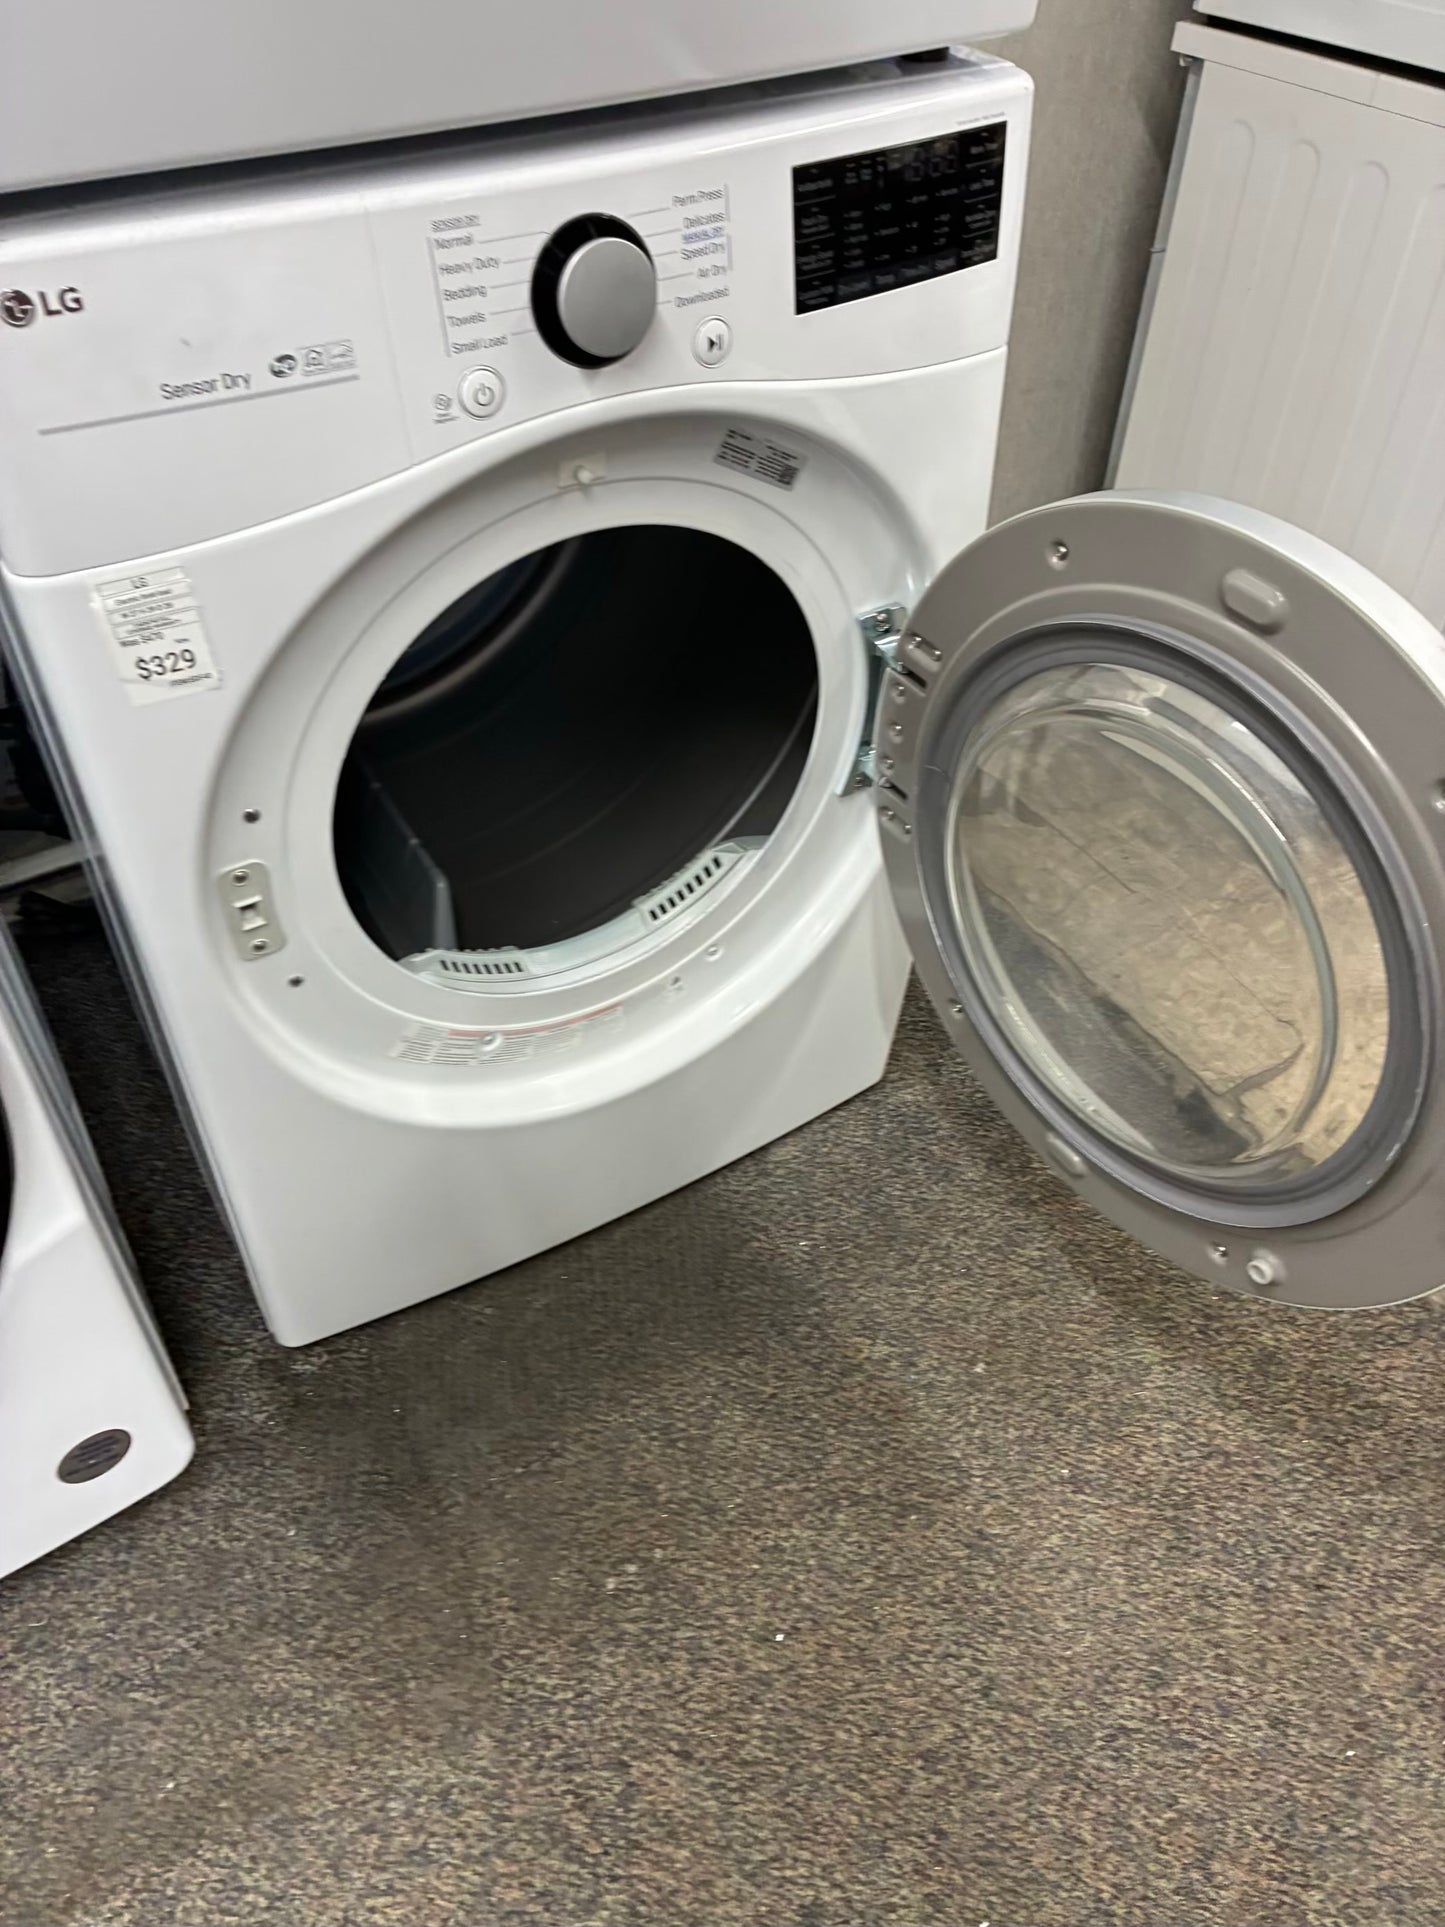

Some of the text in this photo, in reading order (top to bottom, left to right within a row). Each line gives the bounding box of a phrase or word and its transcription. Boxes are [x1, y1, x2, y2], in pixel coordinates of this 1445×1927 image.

[683, 213, 725, 229] Delicates
[434, 234, 473, 249] Normal
[680, 244, 709, 260] Speed
[439, 257, 500, 276] Heavy Duty
[37, 286, 84, 316] LG
[443, 285, 487, 301] Bedding
[675, 287, 729, 308] Downloaded
[446, 311, 487, 327] Towels
[451, 335, 508, 354] Small Load
[160, 373, 252, 400] Sensor Dry
[135, 649, 196, 681] $329
